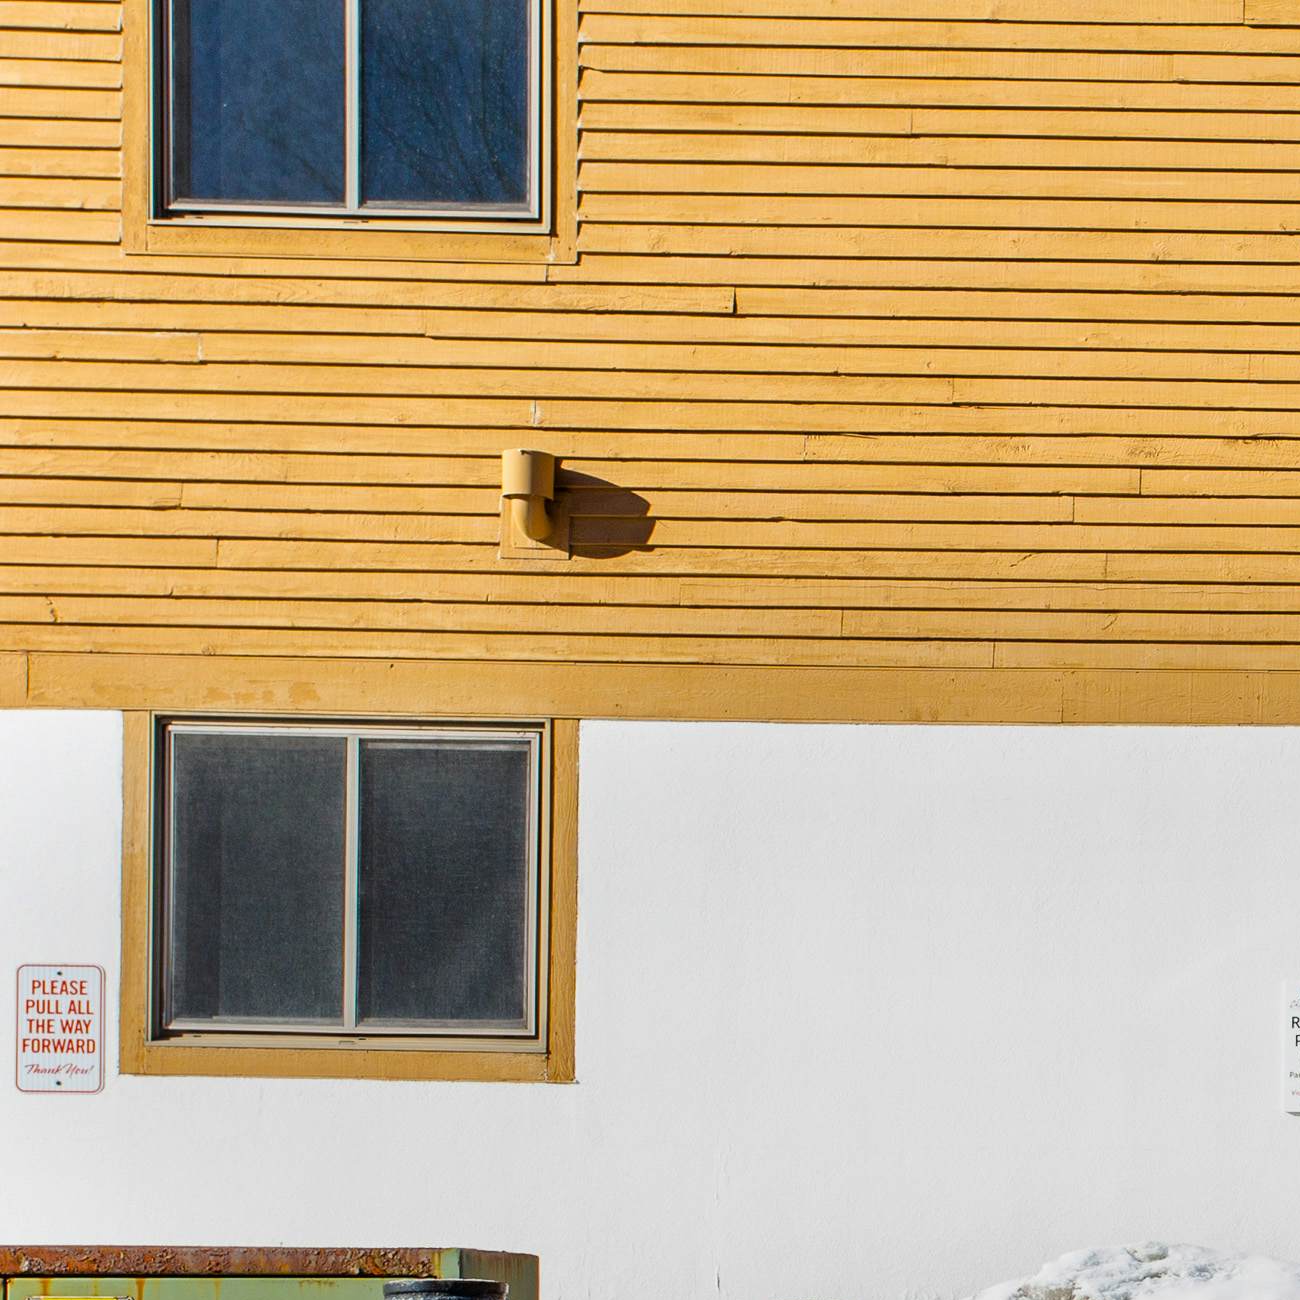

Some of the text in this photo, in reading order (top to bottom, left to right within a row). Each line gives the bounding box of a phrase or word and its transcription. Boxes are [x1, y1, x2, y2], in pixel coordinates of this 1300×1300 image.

[32, 979, 88, 995] PLEASE
[25, 999, 94, 1015] PULL ALL
[27, 1018, 92, 1034] THE WAY
[22, 1038, 96, 1054] FORWARD
[25, 1063, 95, 1079] Thank You!
